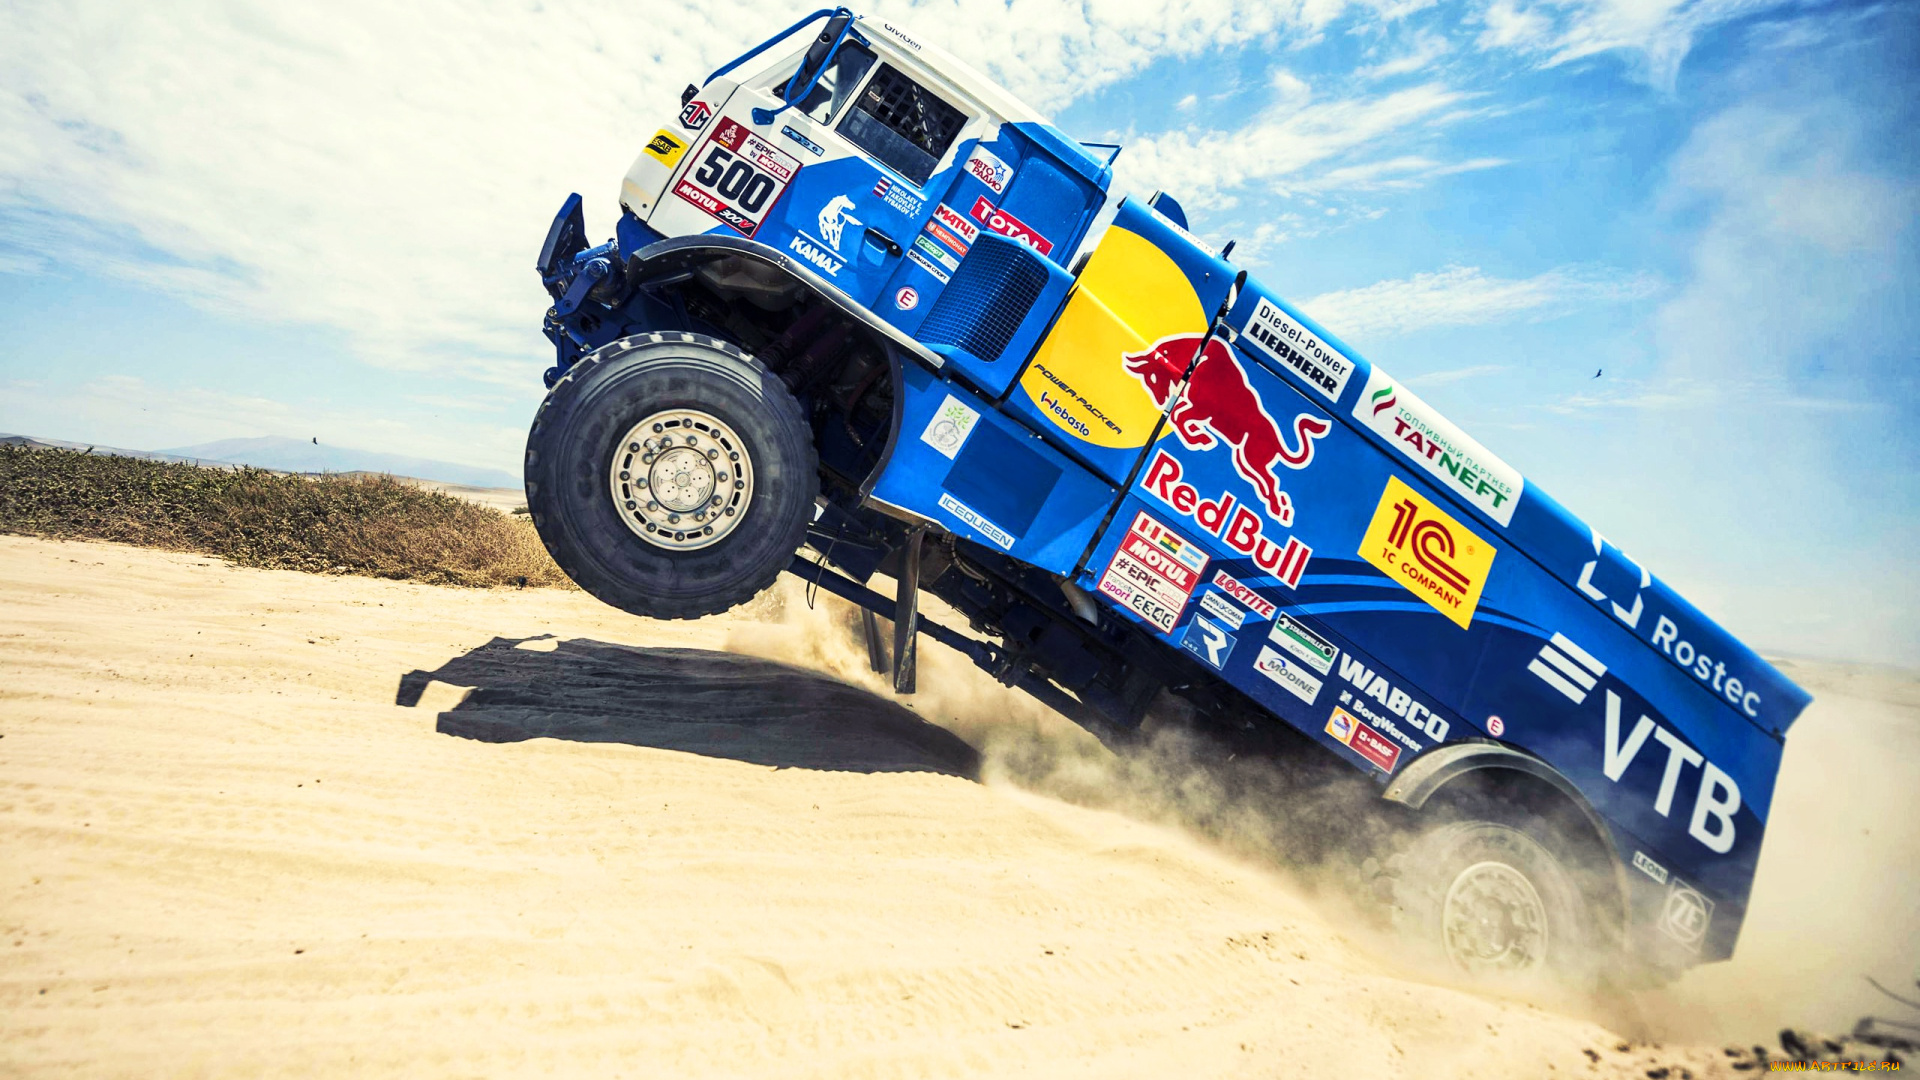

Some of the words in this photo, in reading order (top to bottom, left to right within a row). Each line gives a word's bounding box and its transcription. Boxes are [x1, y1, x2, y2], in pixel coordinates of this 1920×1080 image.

[651, 137, 673, 153] ESAB
[758, 156, 790, 177] MOTUL
[969, 158, 994, 176] АВТО
[680, 183, 721, 212] MOTUL
[695, 146, 776, 214] 500
[888, 189, 916, 211] YAKOVLEV
[890, 184, 918, 205] NIKOLAEV
[972, 166, 1002, 192] РАДИО
[719, 209, 755, 229] 300V
[883, 195, 910, 215] RYBAKOV
[789, 236, 843, 277] KAMAZ
[900, 290, 915, 307] E
[1250, 322, 1338, 395] LIEBHERR
[1260, 305, 1347, 377] Diesel-Power
[1034, 363, 1123, 435] POWER-PACKER
[1041, 391, 1090, 437] Webasto
[1393, 416, 1509, 510] TATNEFT
[1399, 407, 1464, 460] ТОПЛИВНЫЙ
[1465, 455, 1513, 495] ПАРТНЕР
[942, 496, 1011, 547] ICEQUEEN
[1128, 539, 1190, 586] MOTUL
[1103, 580, 1131, 601] sport
[1214, 572, 1275, 616] LOCTITE
[1401, 562, 1462, 609] COMPANY
[1267, 660, 1317, 695] MODINE
[1651, 614, 1761, 718] Rostec
[1338, 652, 1451, 744] WABCO
[1353, 698, 1423, 753] BorgWarner
[1602, 688, 1742, 855] VTB
